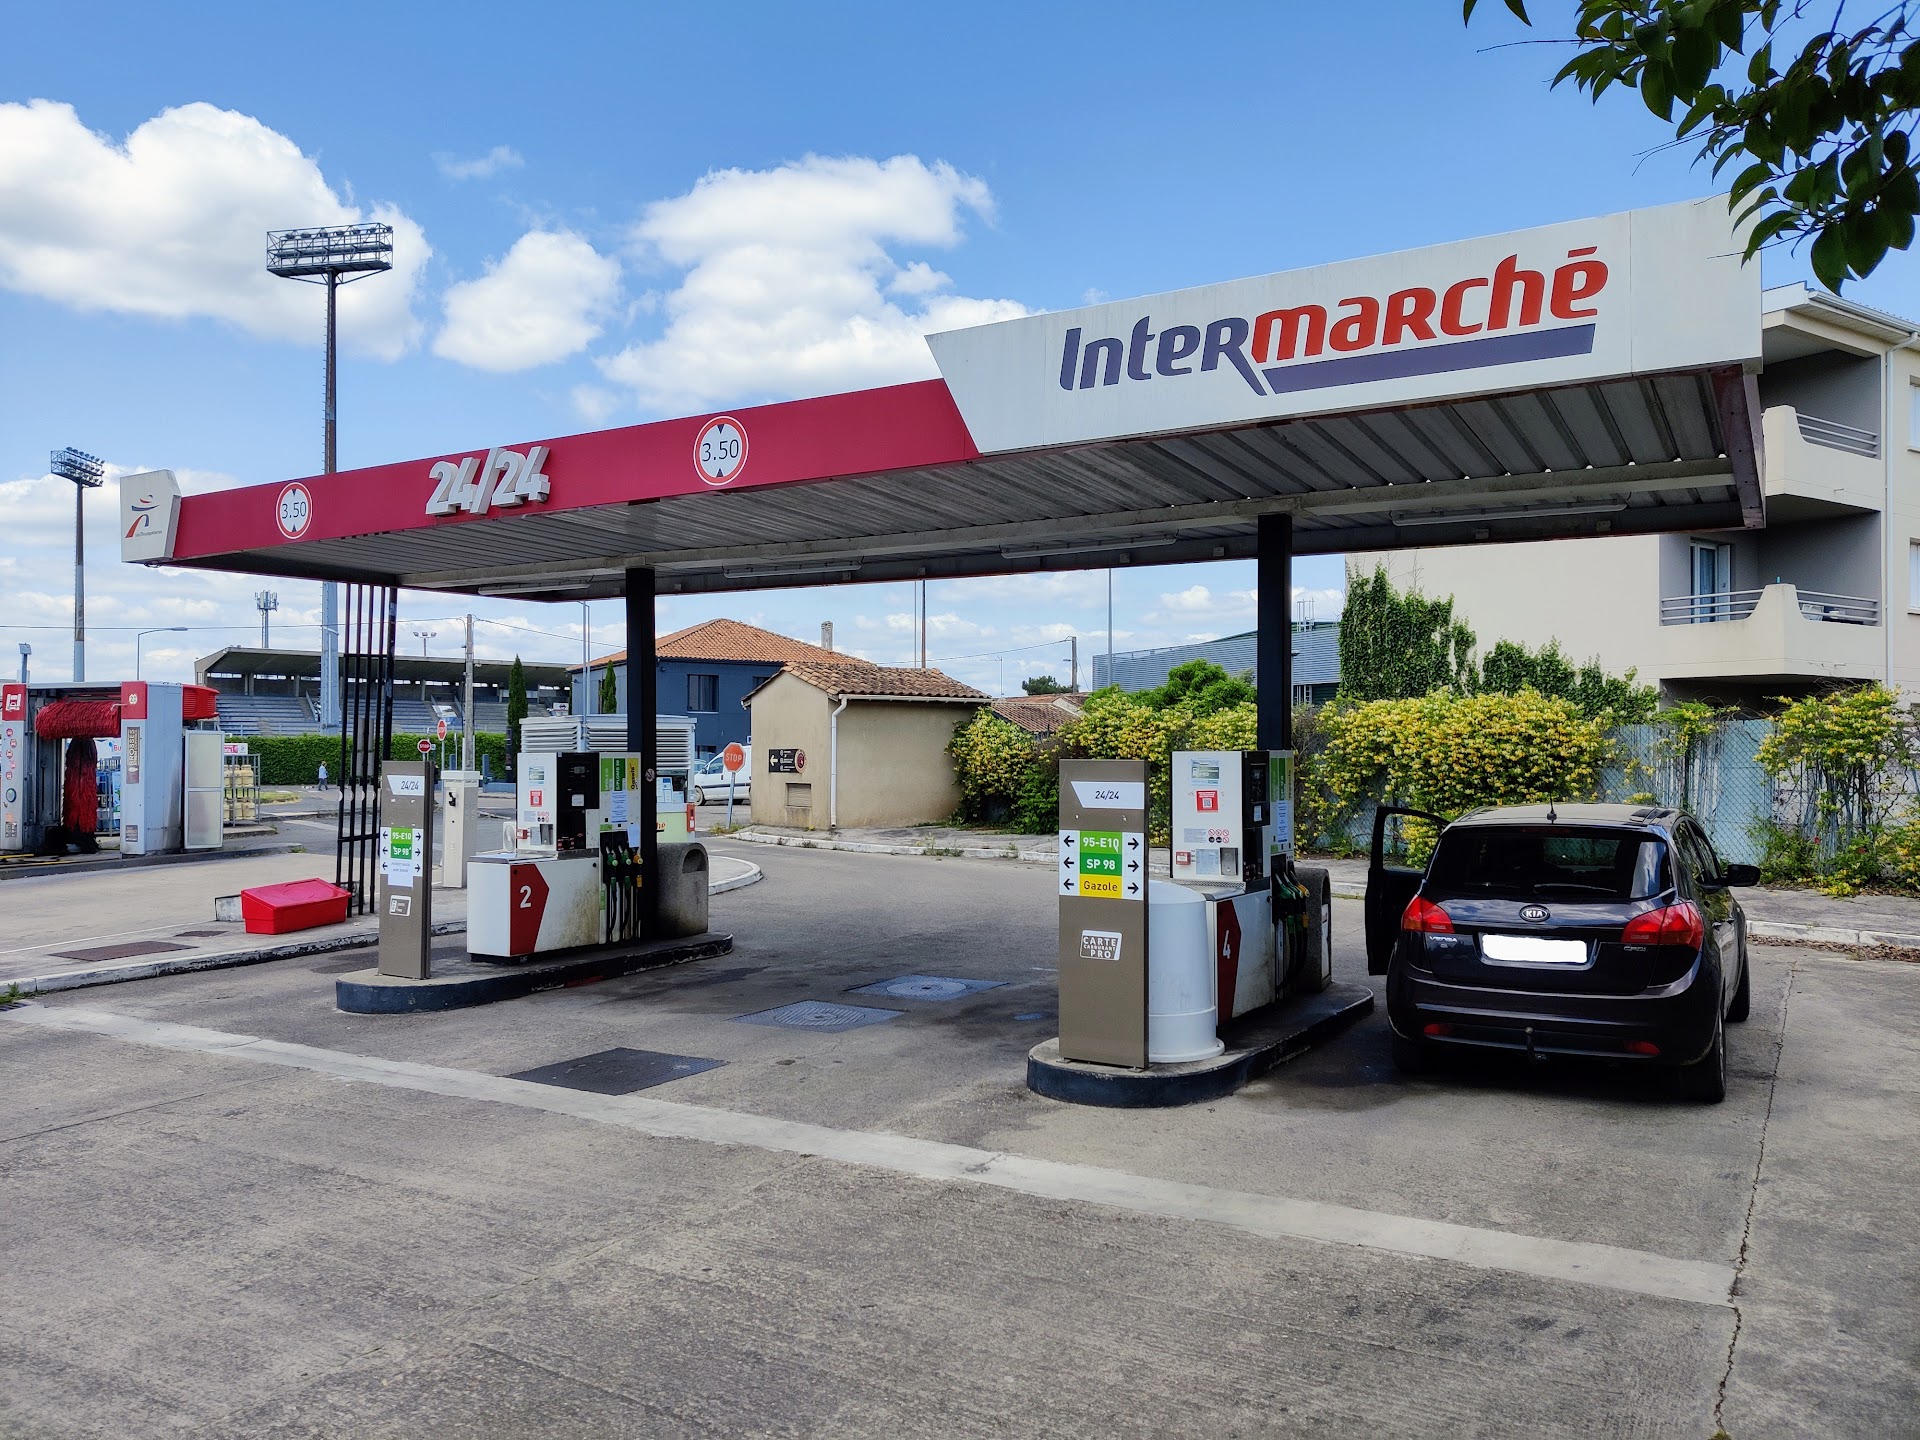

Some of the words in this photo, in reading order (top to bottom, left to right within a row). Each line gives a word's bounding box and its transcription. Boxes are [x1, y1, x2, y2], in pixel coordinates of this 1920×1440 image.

[701, 439, 739, 462] 3.50
[425, 446, 550, 515] 24/24
[281, 501, 307, 519] 3.50
[725, 753, 743, 763] STOP
[400, 781, 419, 791] 24/24
[1095, 790, 1120, 801] 24/24
[392, 832, 412, 840] 95-E10
[1083, 837, 1120, 849] 95-E10
[393, 847, 402, 856] SP
[1086, 858, 1101, 870] SP
[1103, 860, 1116, 871] 98
[1083, 880, 1118, 892] Gazole
[519, 885, 532, 909] 2
[1525, 910, 1543, 918] KIA
[1083, 936, 1117, 947] CARTE
[1222, 929, 1231, 960] 4
[1090, 949, 1111, 959] PRO
